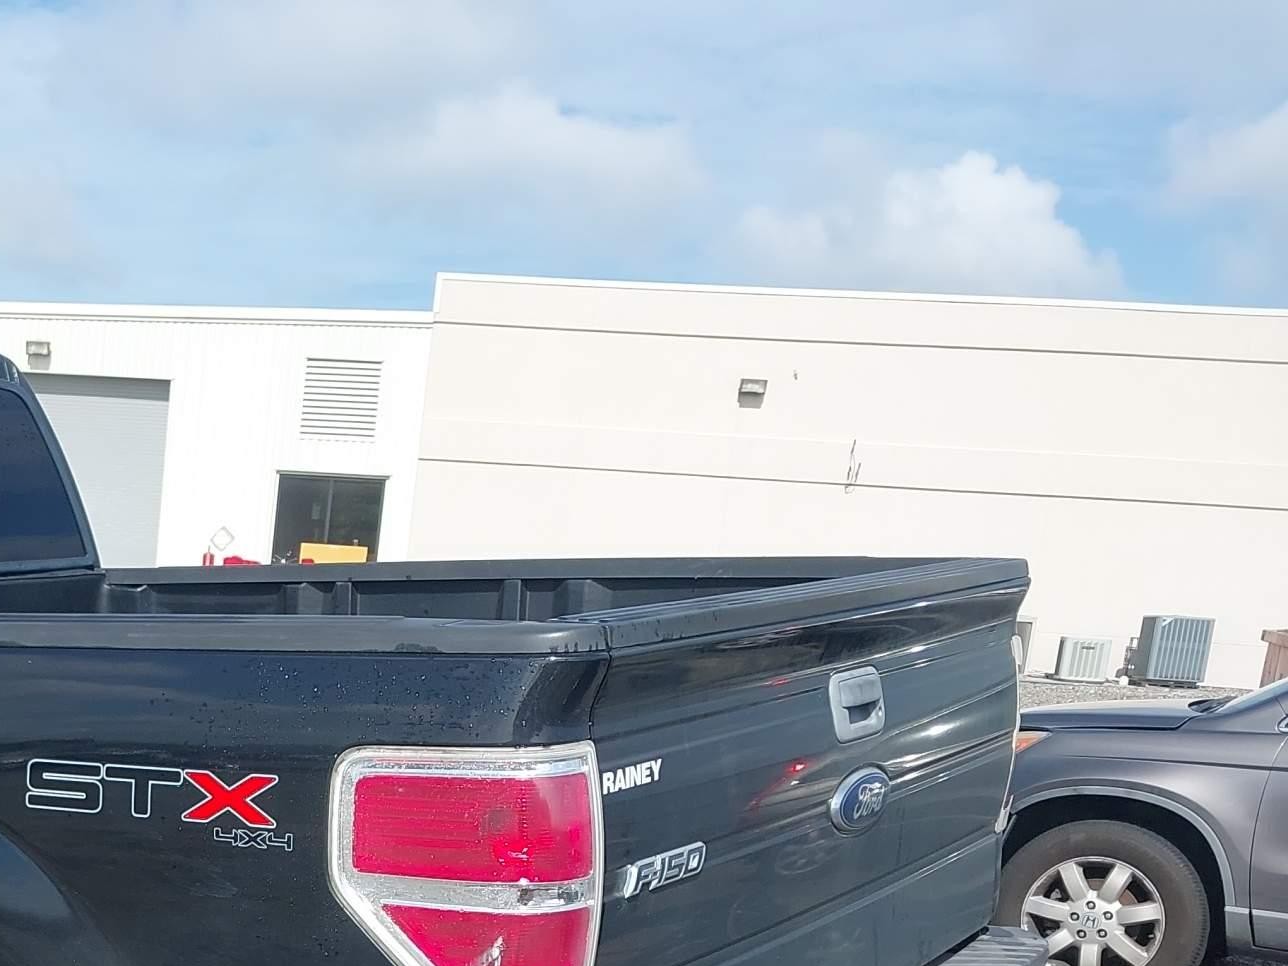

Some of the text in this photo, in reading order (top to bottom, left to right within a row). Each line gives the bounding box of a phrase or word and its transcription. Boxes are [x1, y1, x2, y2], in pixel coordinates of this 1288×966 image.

[26, 758, 279, 828] STX
[602, 758, 662, 795] RAINEY
[624, 841, 706, 899] F-150
